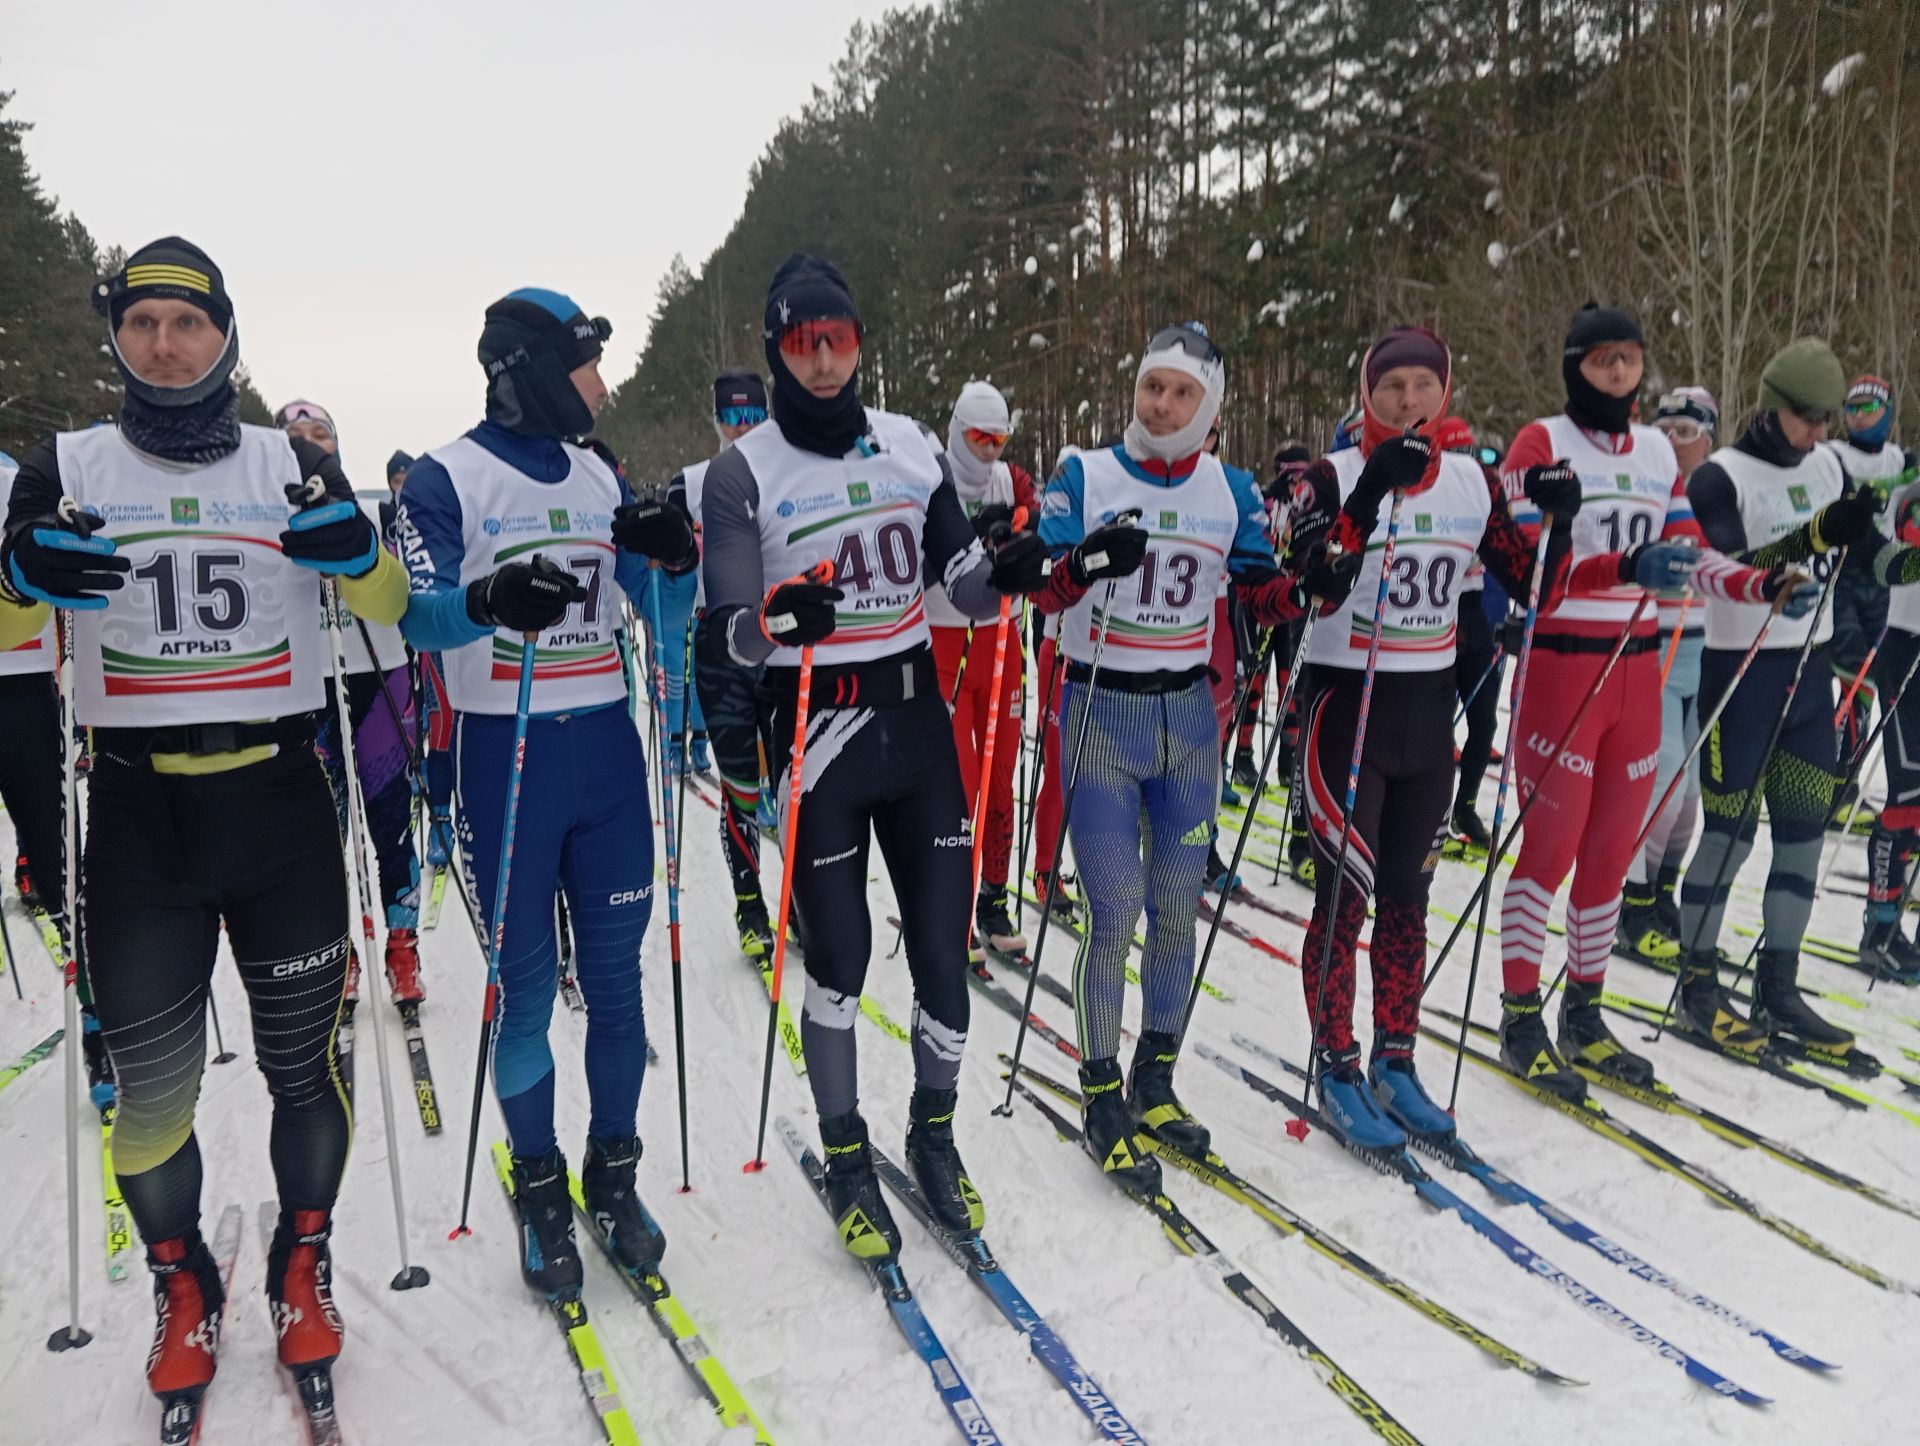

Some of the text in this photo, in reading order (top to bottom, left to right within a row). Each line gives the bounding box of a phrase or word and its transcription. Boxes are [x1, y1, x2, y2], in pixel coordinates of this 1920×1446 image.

[101, 502, 153, 512] Сетевая
[101, 510, 165, 523] Компания
[396, 503, 436, 574] CRAFT
[832, 520, 919, 593] 40
[530, 577, 561, 593] MADSHUS
[1137, 549, 1201, 609] 13
[1388, 554, 1457, 609] 30
[132, 551, 248, 634] 15
[855, 594, 910, 611] АГРЫЗ
[1136, 612, 1181, 625] АГРЫЗ
[1401, 615, 1442, 627] АГРЫЗ
[159, 639, 232, 655] АГРЫЗ
[549, 631, 599, 647] АГРЫЗ
[609, 883, 655, 906] CRAF
[272, 944, 340, 977] CRAFT
[415, 1080, 438, 1127] FISCHER
